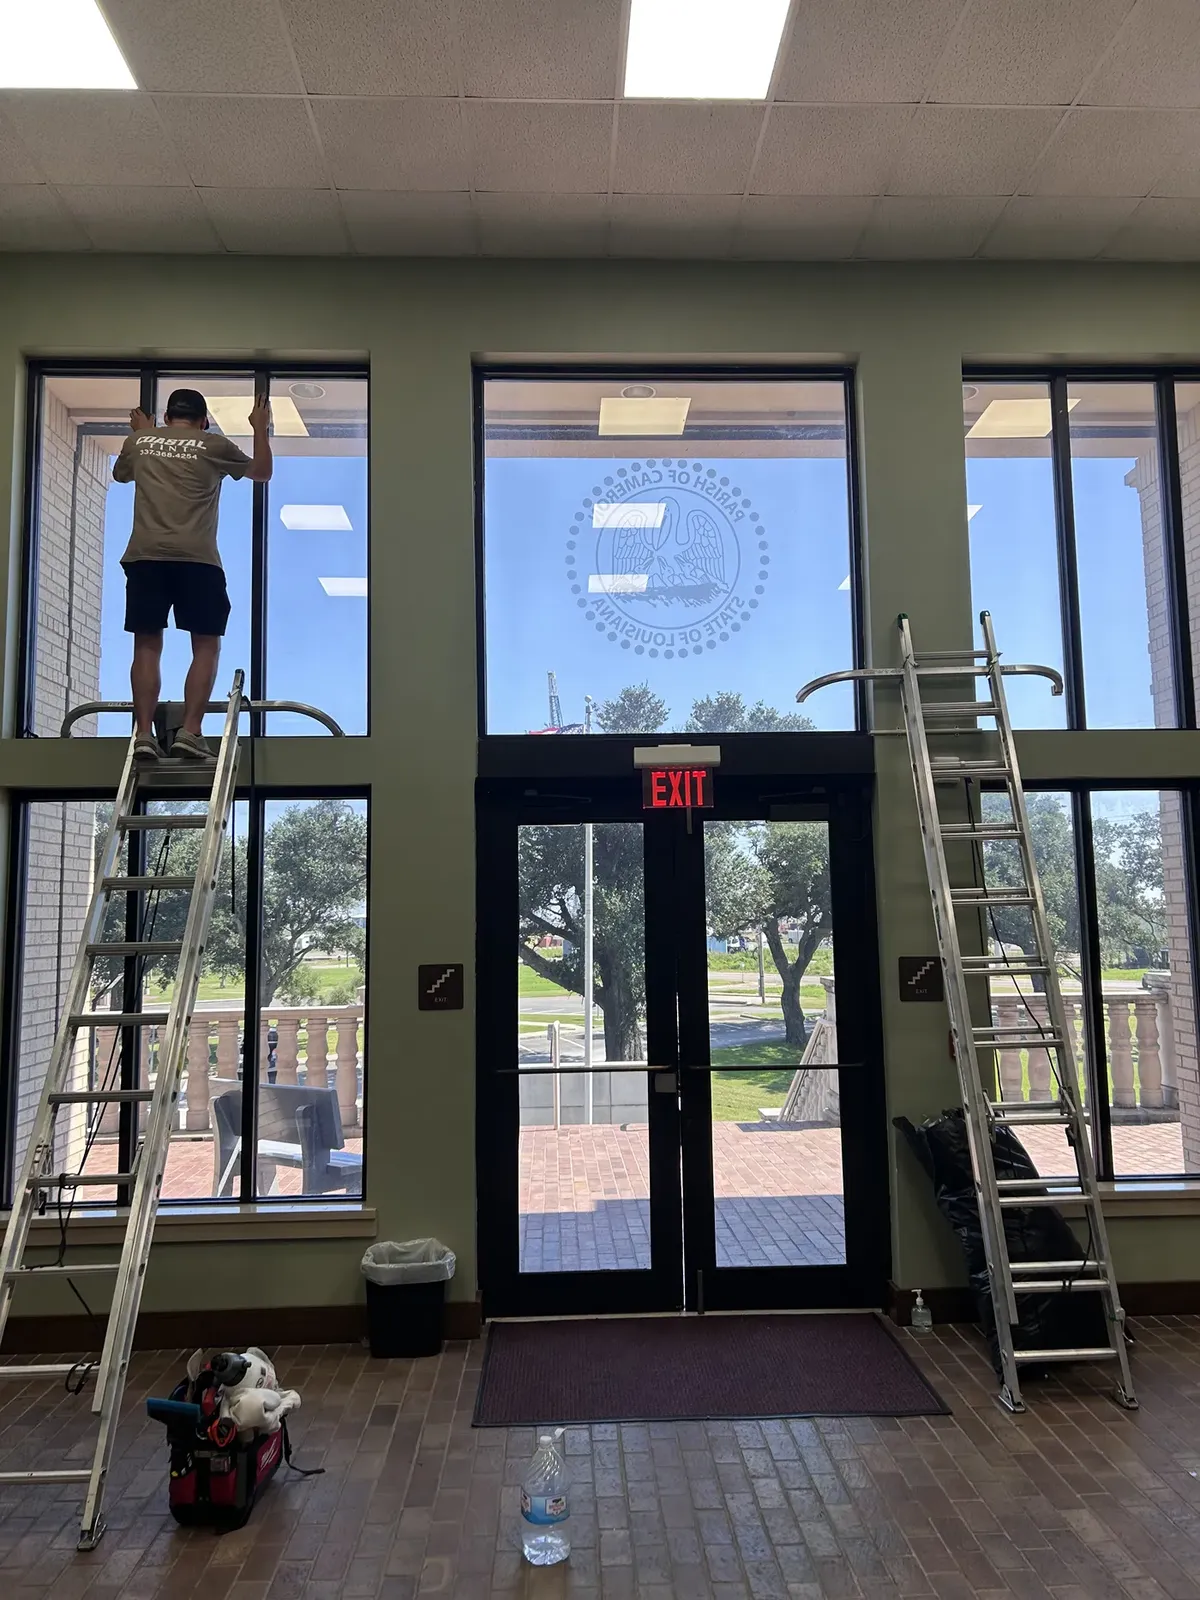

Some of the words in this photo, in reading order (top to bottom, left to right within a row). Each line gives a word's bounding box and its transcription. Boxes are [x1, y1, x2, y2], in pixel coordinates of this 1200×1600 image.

[136, 435, 207, 450] COASTAL
[149, 443, 188, 453] TINT
[651, 770, 707, 807] EXIT
